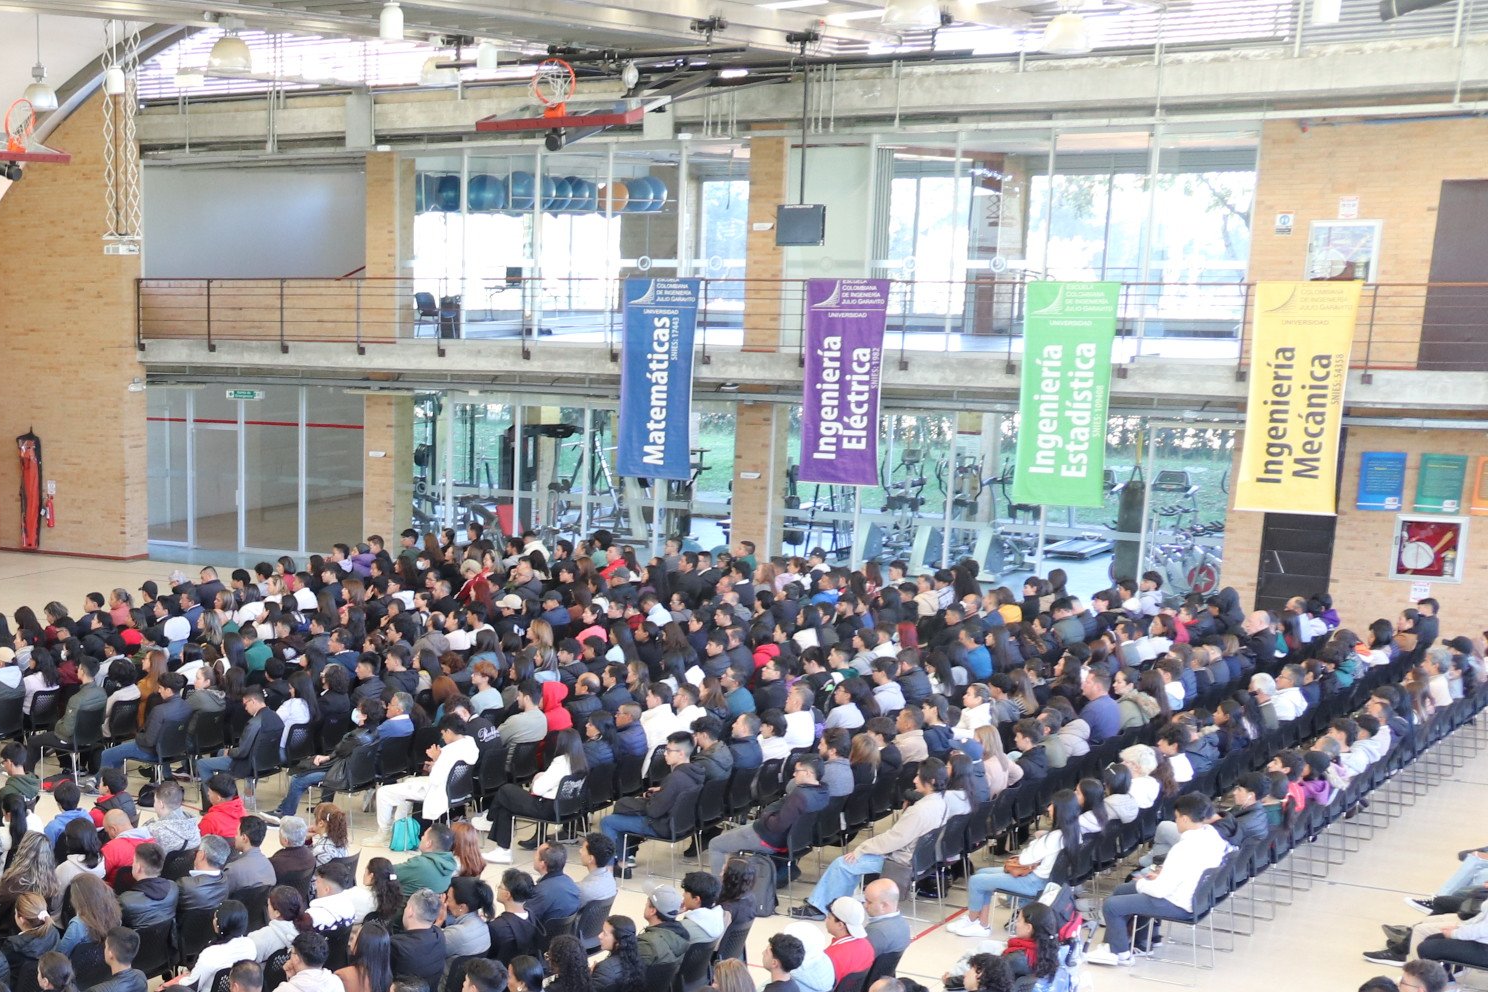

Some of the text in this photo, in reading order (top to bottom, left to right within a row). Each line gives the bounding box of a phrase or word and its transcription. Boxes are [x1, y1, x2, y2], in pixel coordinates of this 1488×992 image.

[643, 317, 670, 466] Matemáticas
[671, 339, 679, 360] SNIES:
[813, 336, 844, 459] Ingeniería
[842, 348, 871, 450] Eléctrica
[1028, 344, 1064, 473] Ingeniería
[1060, 343, 1096, 478] Estadística
[1256, 347, 1295, 483] Ingeniería
[1292, 354, 1332, 479] Mecánica
